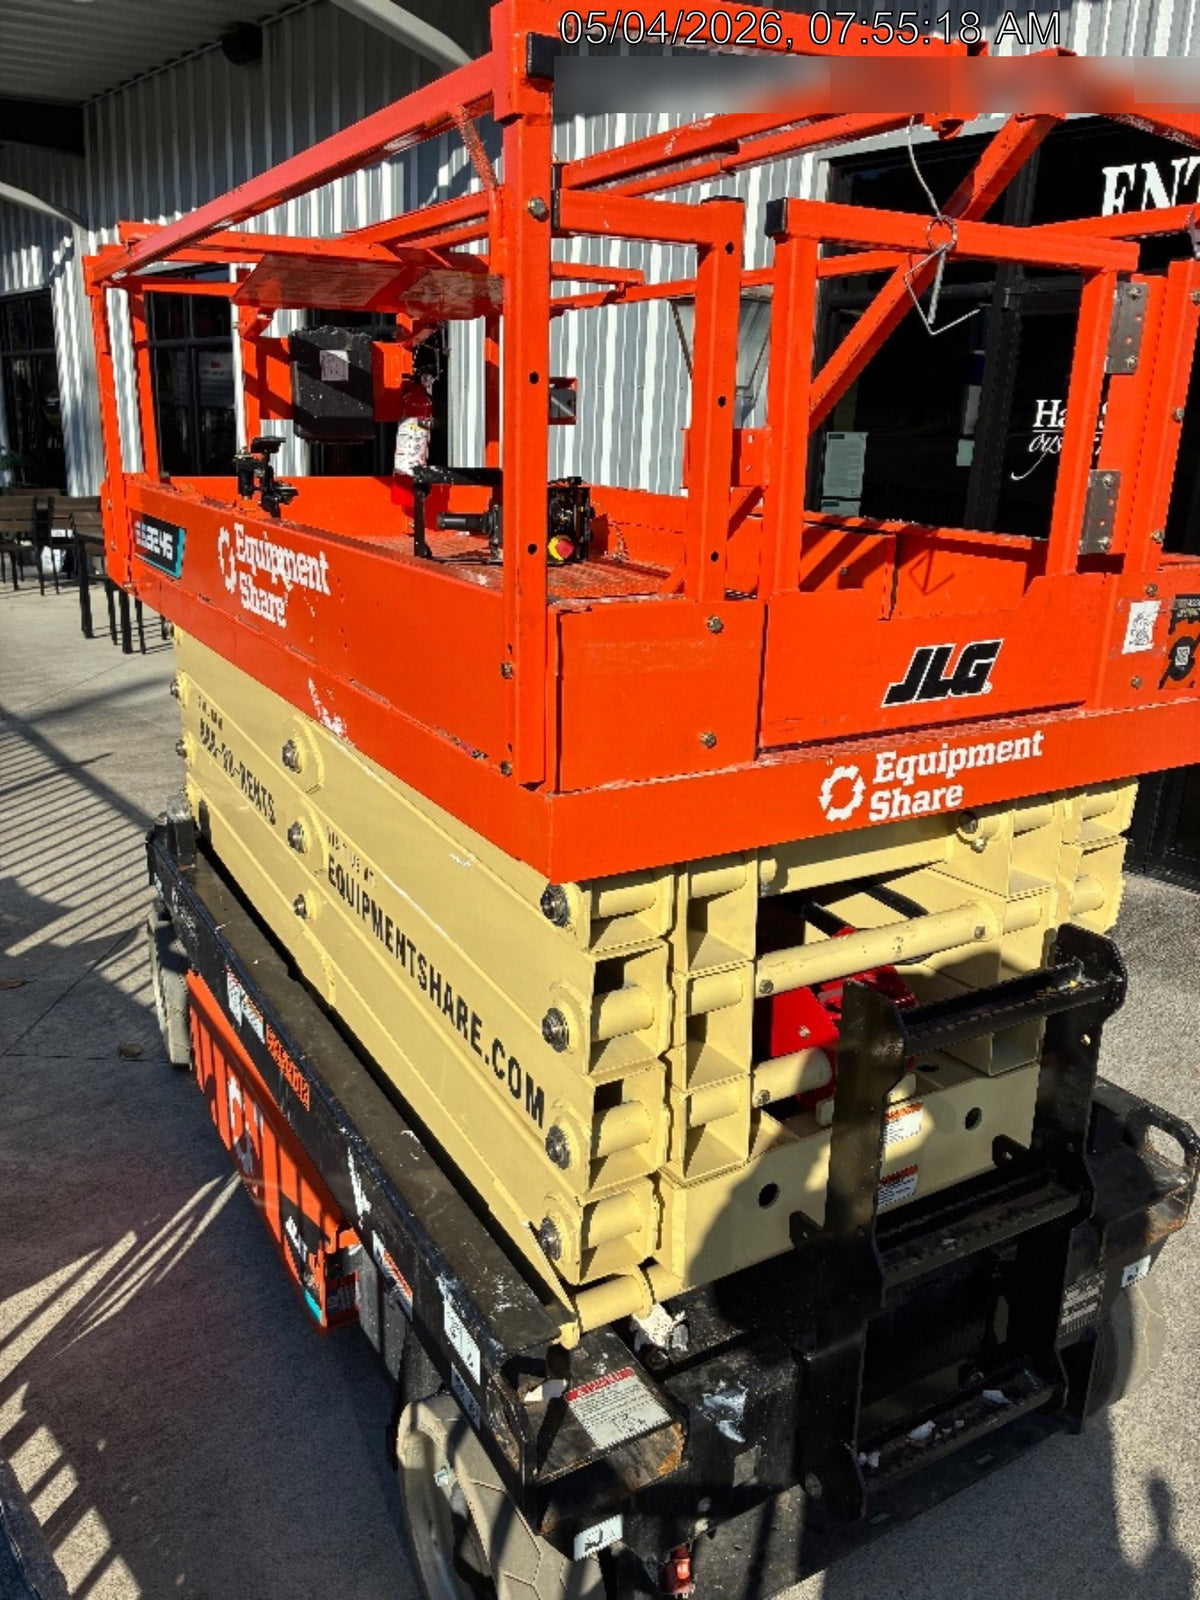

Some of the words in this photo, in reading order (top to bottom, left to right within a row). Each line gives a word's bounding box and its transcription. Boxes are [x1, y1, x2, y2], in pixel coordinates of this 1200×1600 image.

[234, 521, 331, 597] Equipment
[239, 570, 287, 629] Share
[880, 638, 1004, 708] JLG
[872, 730, 1045, 787] Equipment
[868, 783, 964, 823] Share
[327, 852, 545, 1130] EQUIPMENTSHARE.COM
